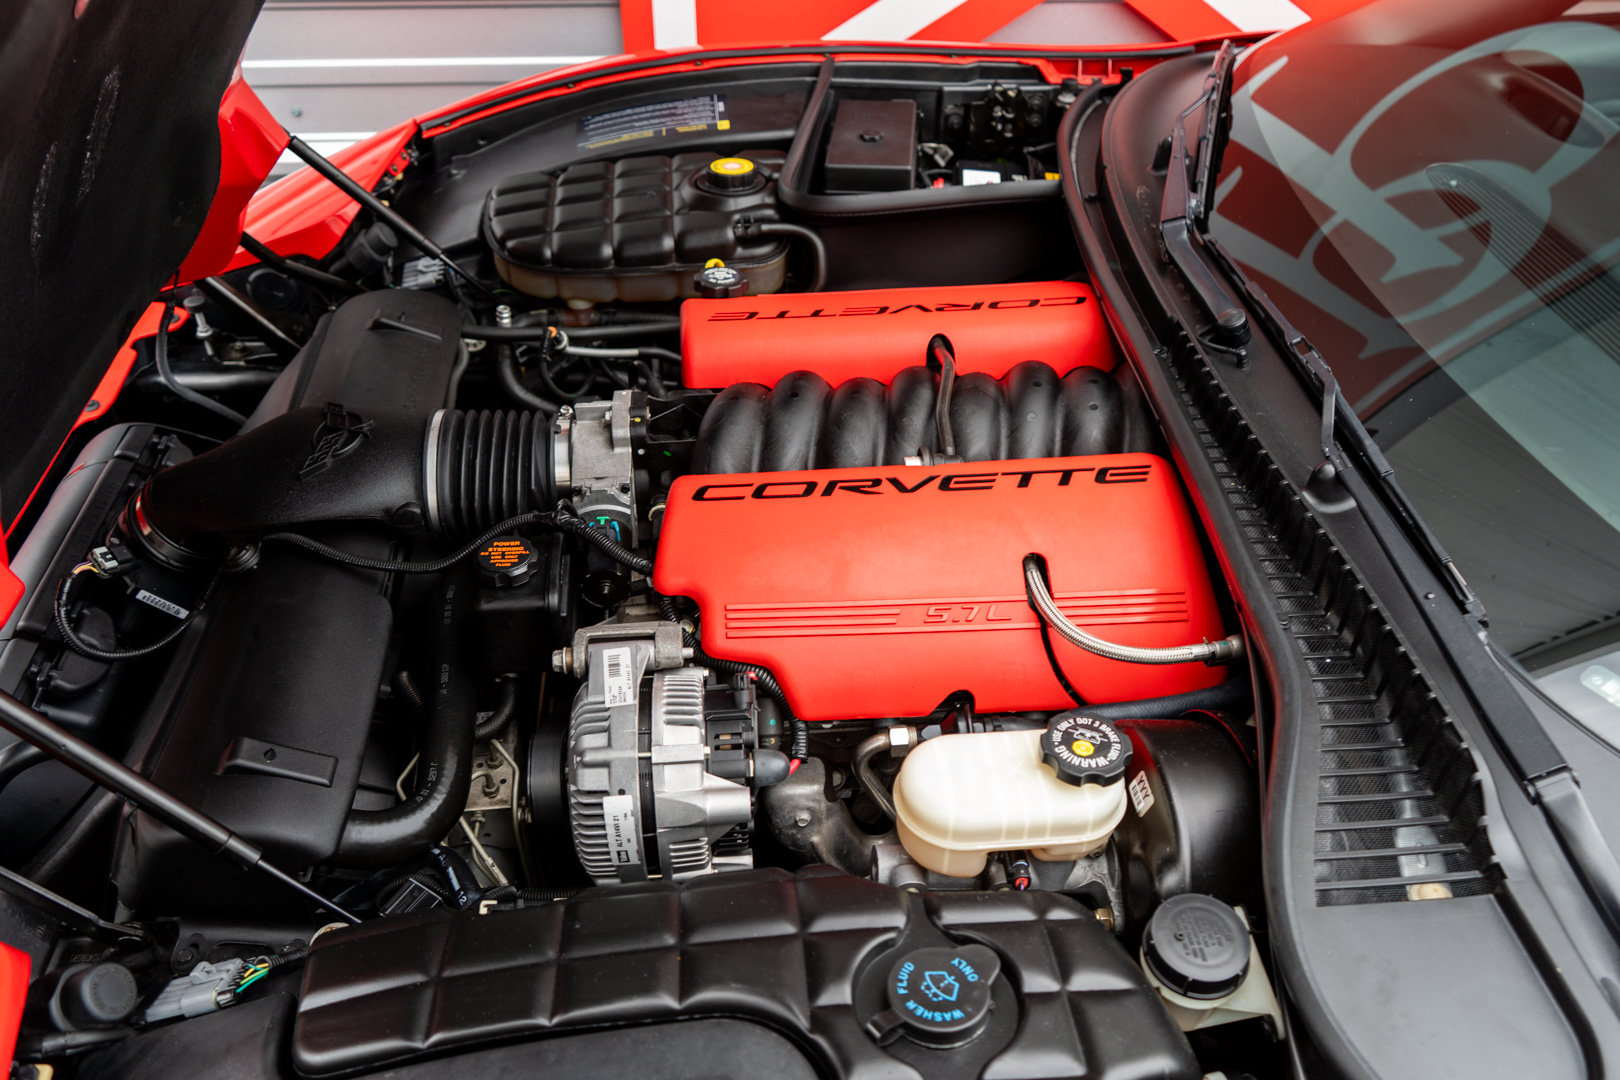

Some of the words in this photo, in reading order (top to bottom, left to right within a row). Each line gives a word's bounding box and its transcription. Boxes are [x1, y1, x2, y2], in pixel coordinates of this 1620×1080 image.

[707, 296, 1087, 321] CORVETTE
[691, 464, 1152, 502] CORVETTE
[923, 604, 1012, 624] 5.7L
[1056, 717, 1076, 732] ONLY
[1075, 717, 1094, 726] DOT
[1093, 719, 1101, 728] 3
[1052, 730, 1064, 742] USE
[1098, 723, 1121, 743] BRAKE
[1054, 744, 1110, 768] WARNING
[1109, 742, 1122, 761] FLUID
[1137, 773, 1150, 800] YYY
[616, 839, 624, 848] ALT
[457, 890, 467, 906] 12
[896, 961, 915, 995] FLUID
[949, 956, 980, 983] ONLY
[904, 999, 966, 1023] WASHER
